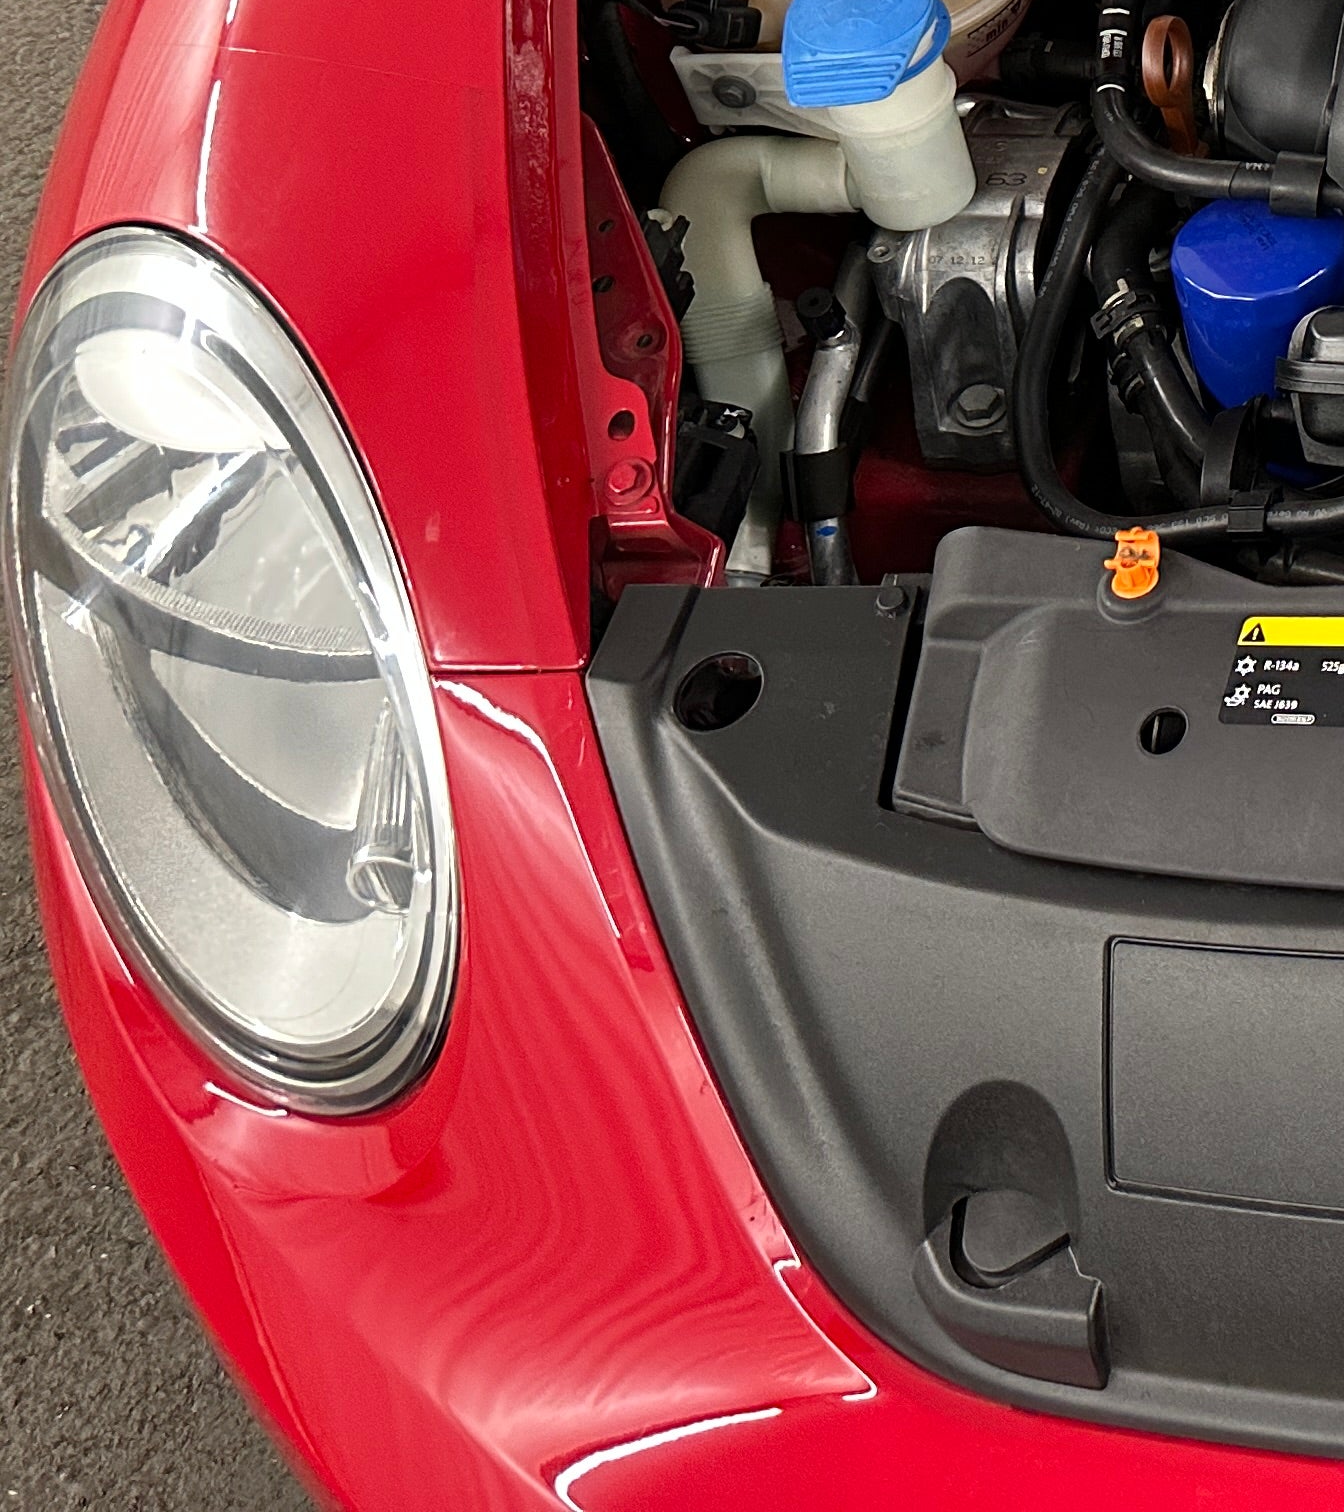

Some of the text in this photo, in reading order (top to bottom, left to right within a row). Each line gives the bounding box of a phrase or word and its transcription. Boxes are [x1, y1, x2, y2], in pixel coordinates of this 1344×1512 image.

[986, 18, 1009, 42] min
[1263, 660, 1300, 672] R-134a
[1256, 684, 1281, 695] PAG
[1253, 699, 1273, 710] SAE
